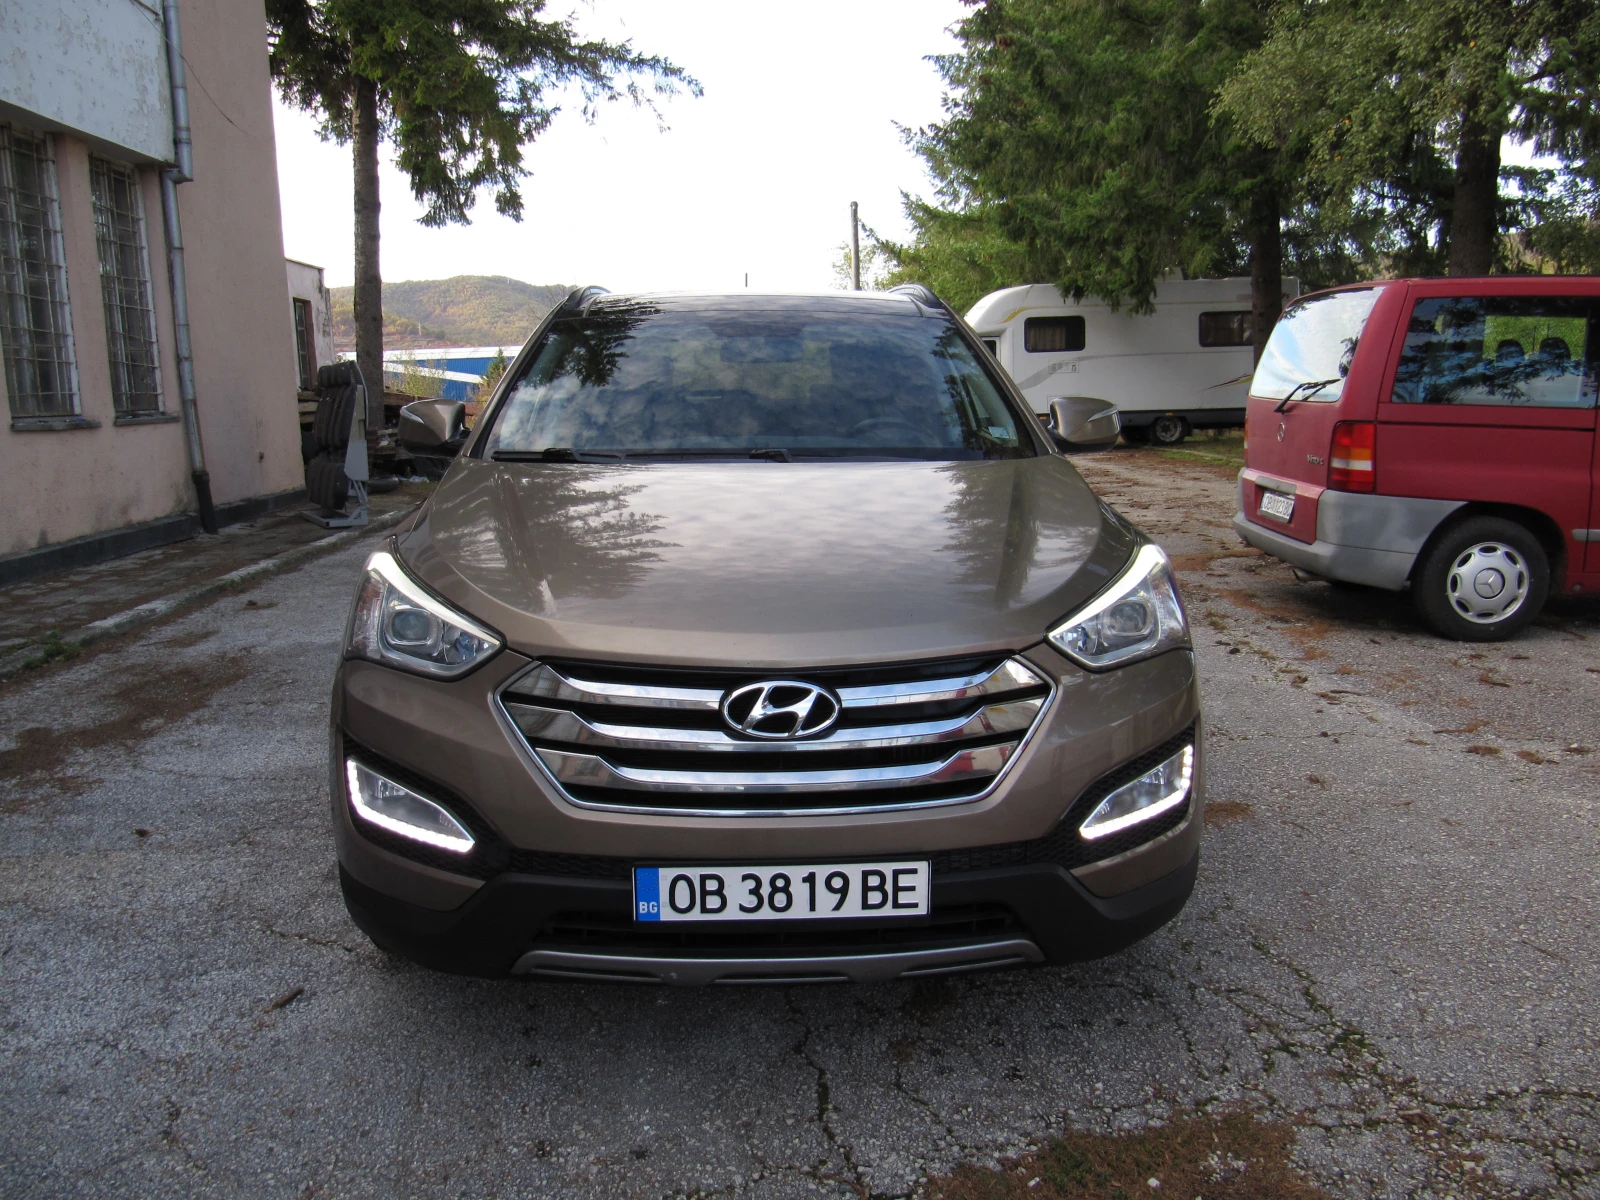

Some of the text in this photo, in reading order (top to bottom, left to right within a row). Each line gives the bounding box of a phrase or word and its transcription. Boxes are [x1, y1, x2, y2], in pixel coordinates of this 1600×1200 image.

[668, 867, 919, 914] OB 3819 BE
[639, 901, 658, 914] BG
